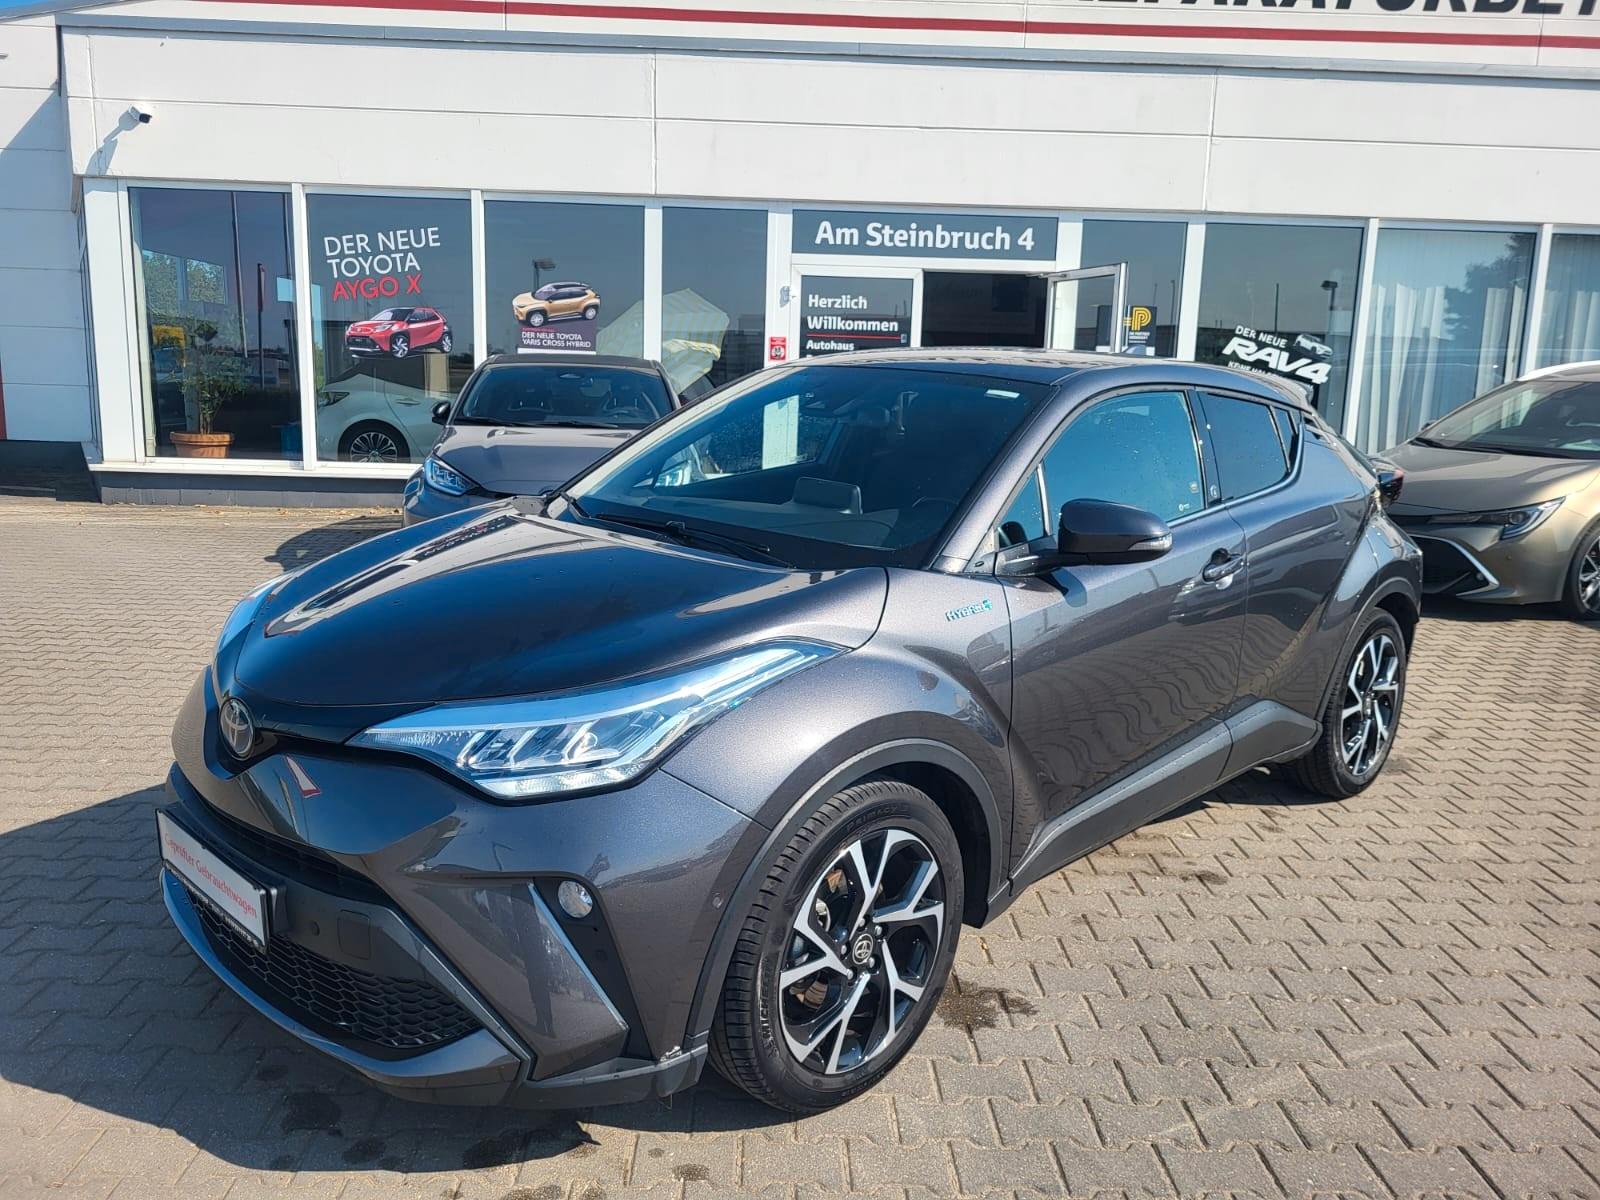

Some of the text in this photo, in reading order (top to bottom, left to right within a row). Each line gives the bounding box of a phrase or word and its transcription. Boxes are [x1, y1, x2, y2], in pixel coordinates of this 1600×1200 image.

[323, 227, 441, 257] DER NEUE
[815, 220, 1035, 251] Am Steinbruch 4
[327, 252, 421, 279] TOYOTA
[332, 274, 422, 301] AYGO X
[808, 294, 868, 310] Herzlich
[807, 315, 899, 332] Willkommen
[521, 331, 583, 341] DER NEUE TOYOTA
[522, 338, 591, 348] YARIS CROSS HYBRID
[806, 339, 855, 351] Autohaus
[1235, 325, 1288, 349] DER NEUE
[1222, 336, 1332, 384] RAV4
